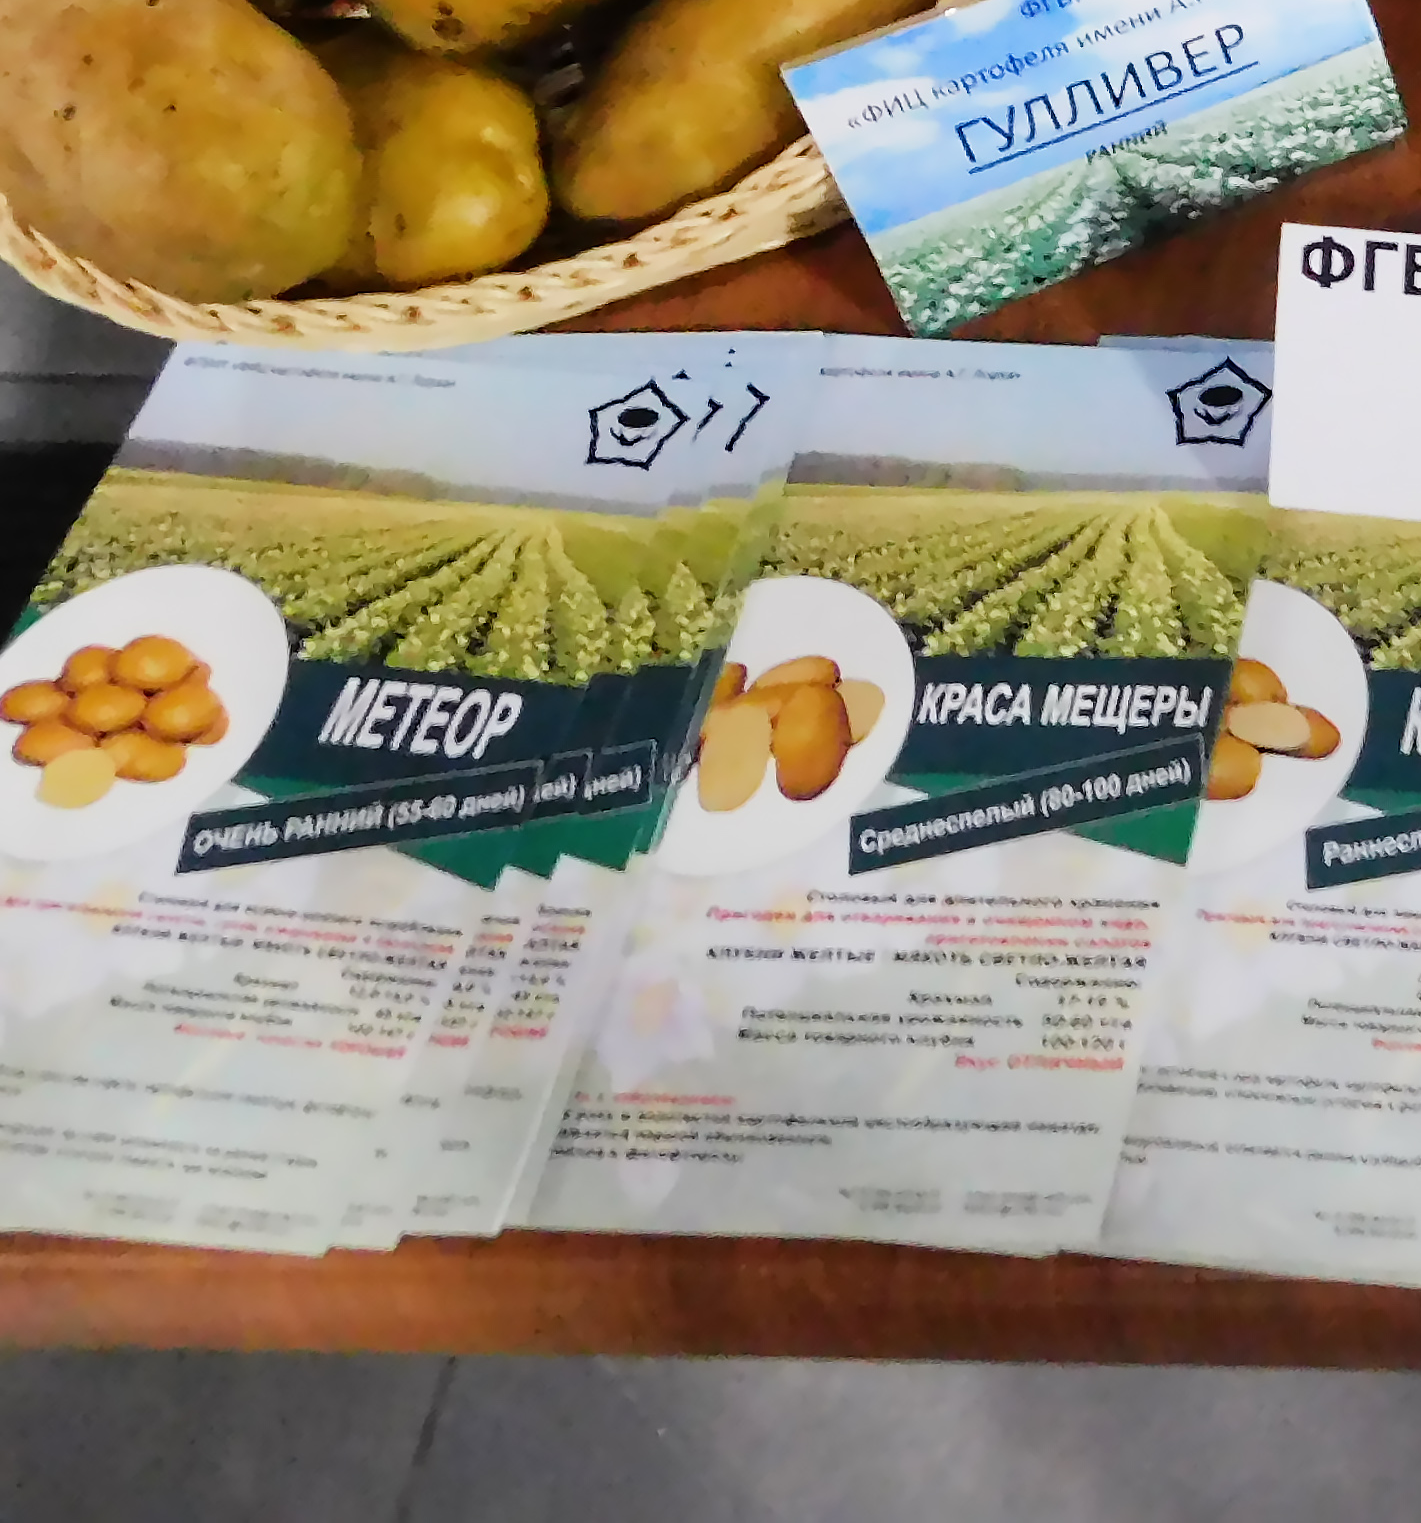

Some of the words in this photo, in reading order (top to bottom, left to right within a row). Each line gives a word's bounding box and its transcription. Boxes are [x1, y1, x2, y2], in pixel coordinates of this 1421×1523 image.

[846, 88, 929, 131] «ФИЦ
[931, 37, 1070, 105] картофеля
[1076, 6, 1163, 51] имени
[953, 22, 1247, 165] ГУЛЛИВЕР
[318, 676, 523, 759] МЕТЕОР
[917, 681, 1032, 727] КРАСА
[1040, 683, 1214, 735] МЕЩЕРЫ
[192, 820, 281, 855] ОЧЕНЬ
[282, 801, 384, 843] РАННИЙ
[859, 792, 1036, 855] Среднеспелый
[1125, 757, 1192, 797] дней)
